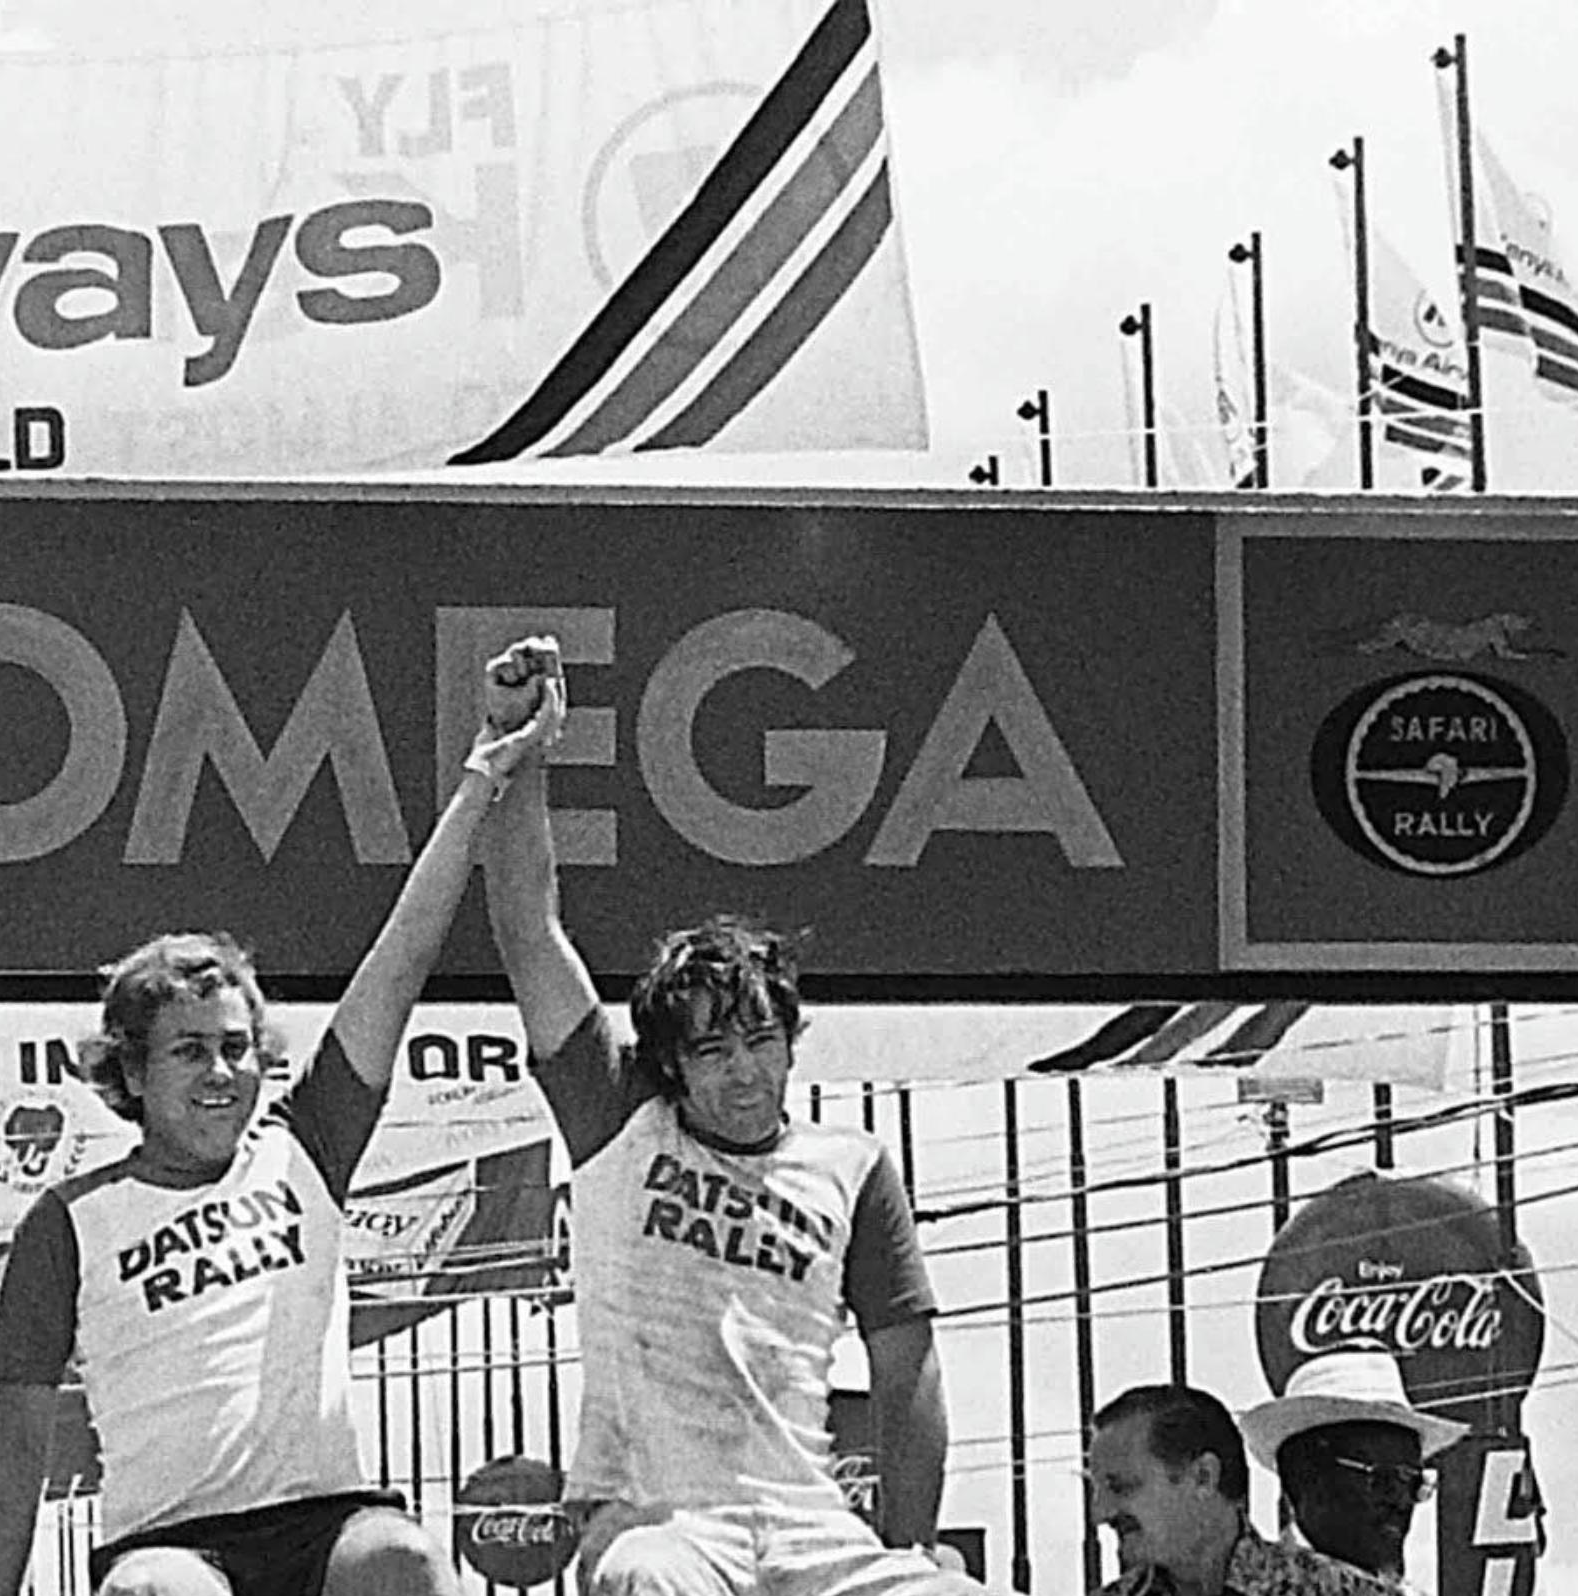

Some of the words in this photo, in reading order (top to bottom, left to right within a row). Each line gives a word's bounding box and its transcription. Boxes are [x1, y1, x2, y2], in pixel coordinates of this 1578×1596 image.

[1390, 715, 1498, 743] SAFARI
[1394, 811, 1495, 837] RALLY
[119, 1180, 303, 1282] DATSUN
[143, 1224, 305, 1312] RALLY
[643, 1199, 814, 1281] RALLY
